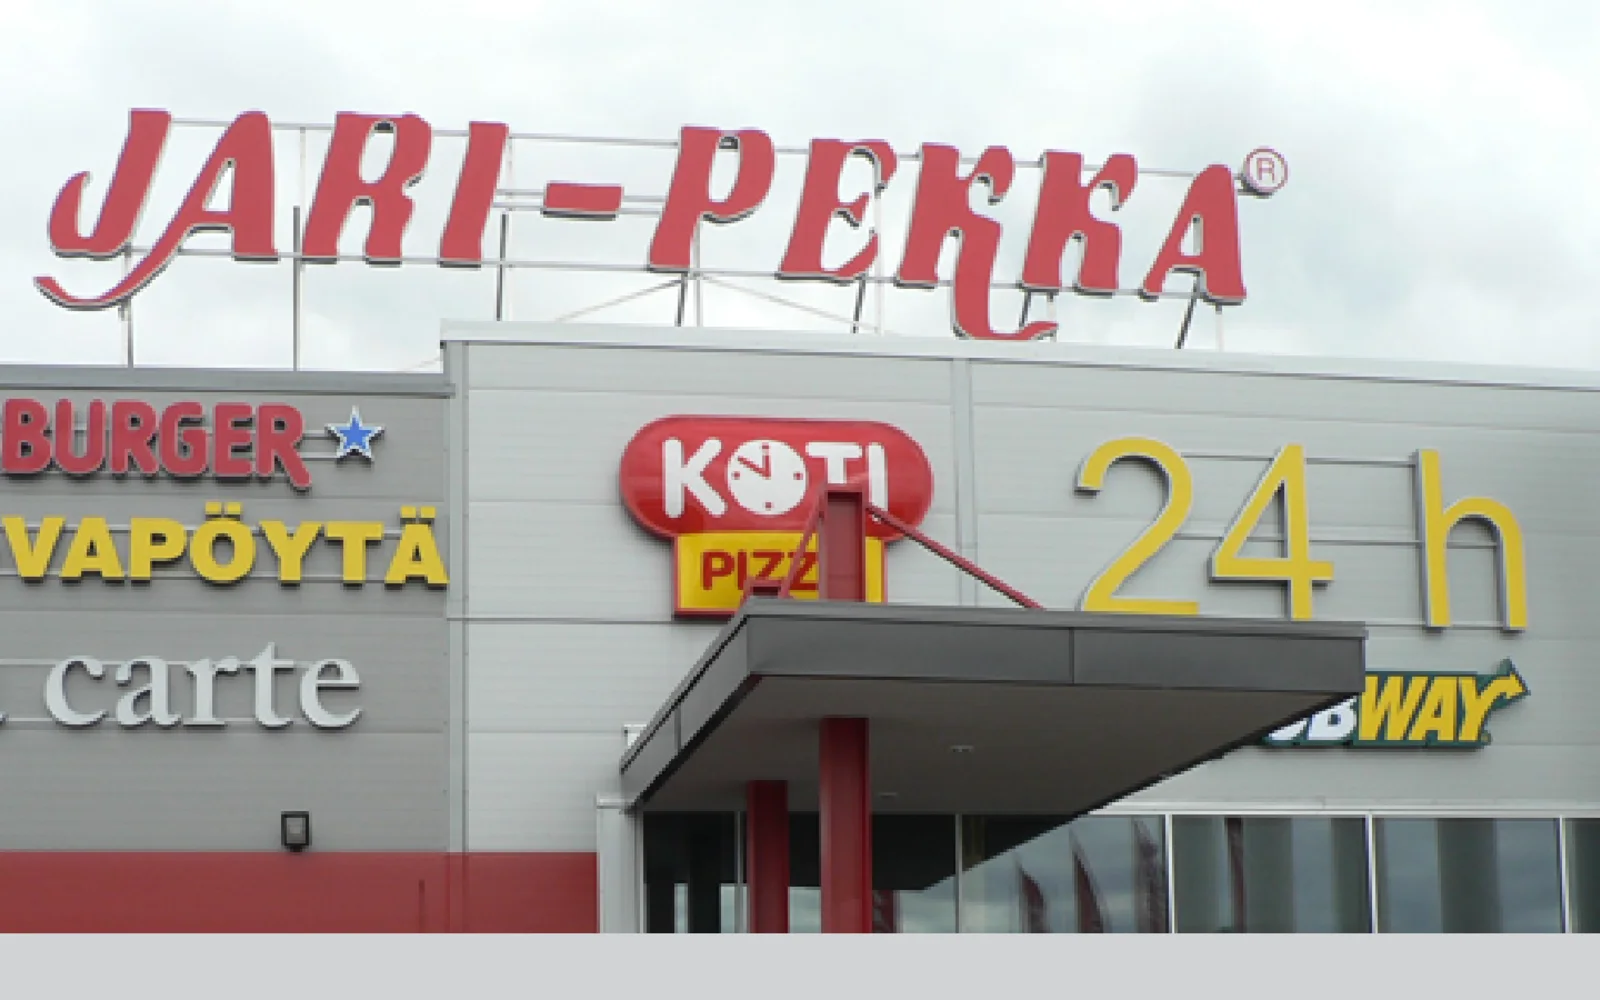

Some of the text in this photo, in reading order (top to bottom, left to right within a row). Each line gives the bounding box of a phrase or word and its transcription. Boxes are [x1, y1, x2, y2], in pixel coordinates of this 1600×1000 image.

[34, 107, 1247, 341] JARI-PEKKA
[2, 398, 313, 488] BURGER
[662, 437, 889, 520] KOTI
[2, 502, 449, 586] VAPÖYTÄ
[702, 549, 820, 591] PIZZ
[1077, 437, 1527, 629] 24 h
[45, 642, 362, 728] carte
[1264, 673, 1528, 742] BWAY
